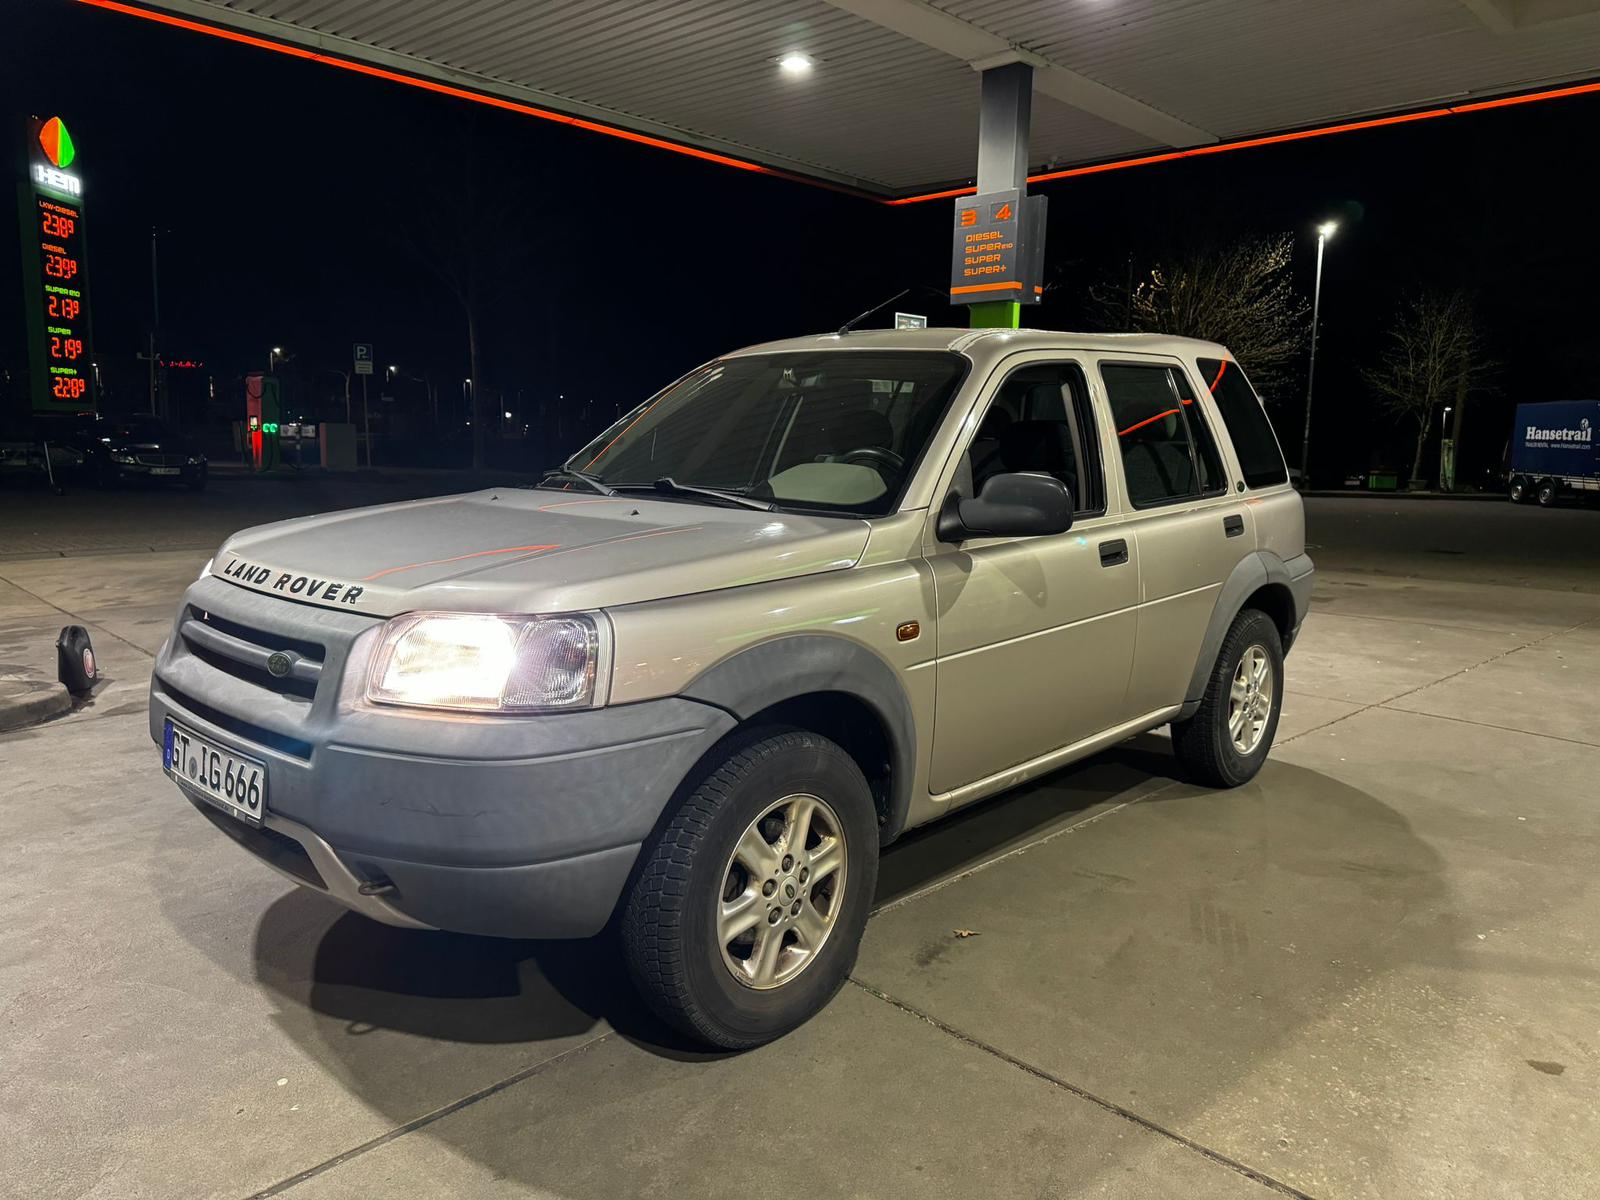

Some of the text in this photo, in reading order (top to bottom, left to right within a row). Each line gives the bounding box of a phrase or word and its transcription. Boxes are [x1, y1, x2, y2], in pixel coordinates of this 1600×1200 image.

[39, 200, 79, 218] LKW-DIESEL
[960, 203, 1012, 226] 3 4
[965, 231, 1004, 243] DIESEL
[42, 243, 67, 255] DIESEL
[964, 254, 1001, 265] SUPER
[963, 265, 1007, 277] SUPER+
[45, 285, 69, 296] SUPER
[47, 326, 72, 336] SUPER
[50, 366, 78, 376] SUPER+
[1525, 426, 1592, 442] Hansetrail
[223, 559, 364, 605] LAND ROVER
[172, 730, 190, 772] GT
